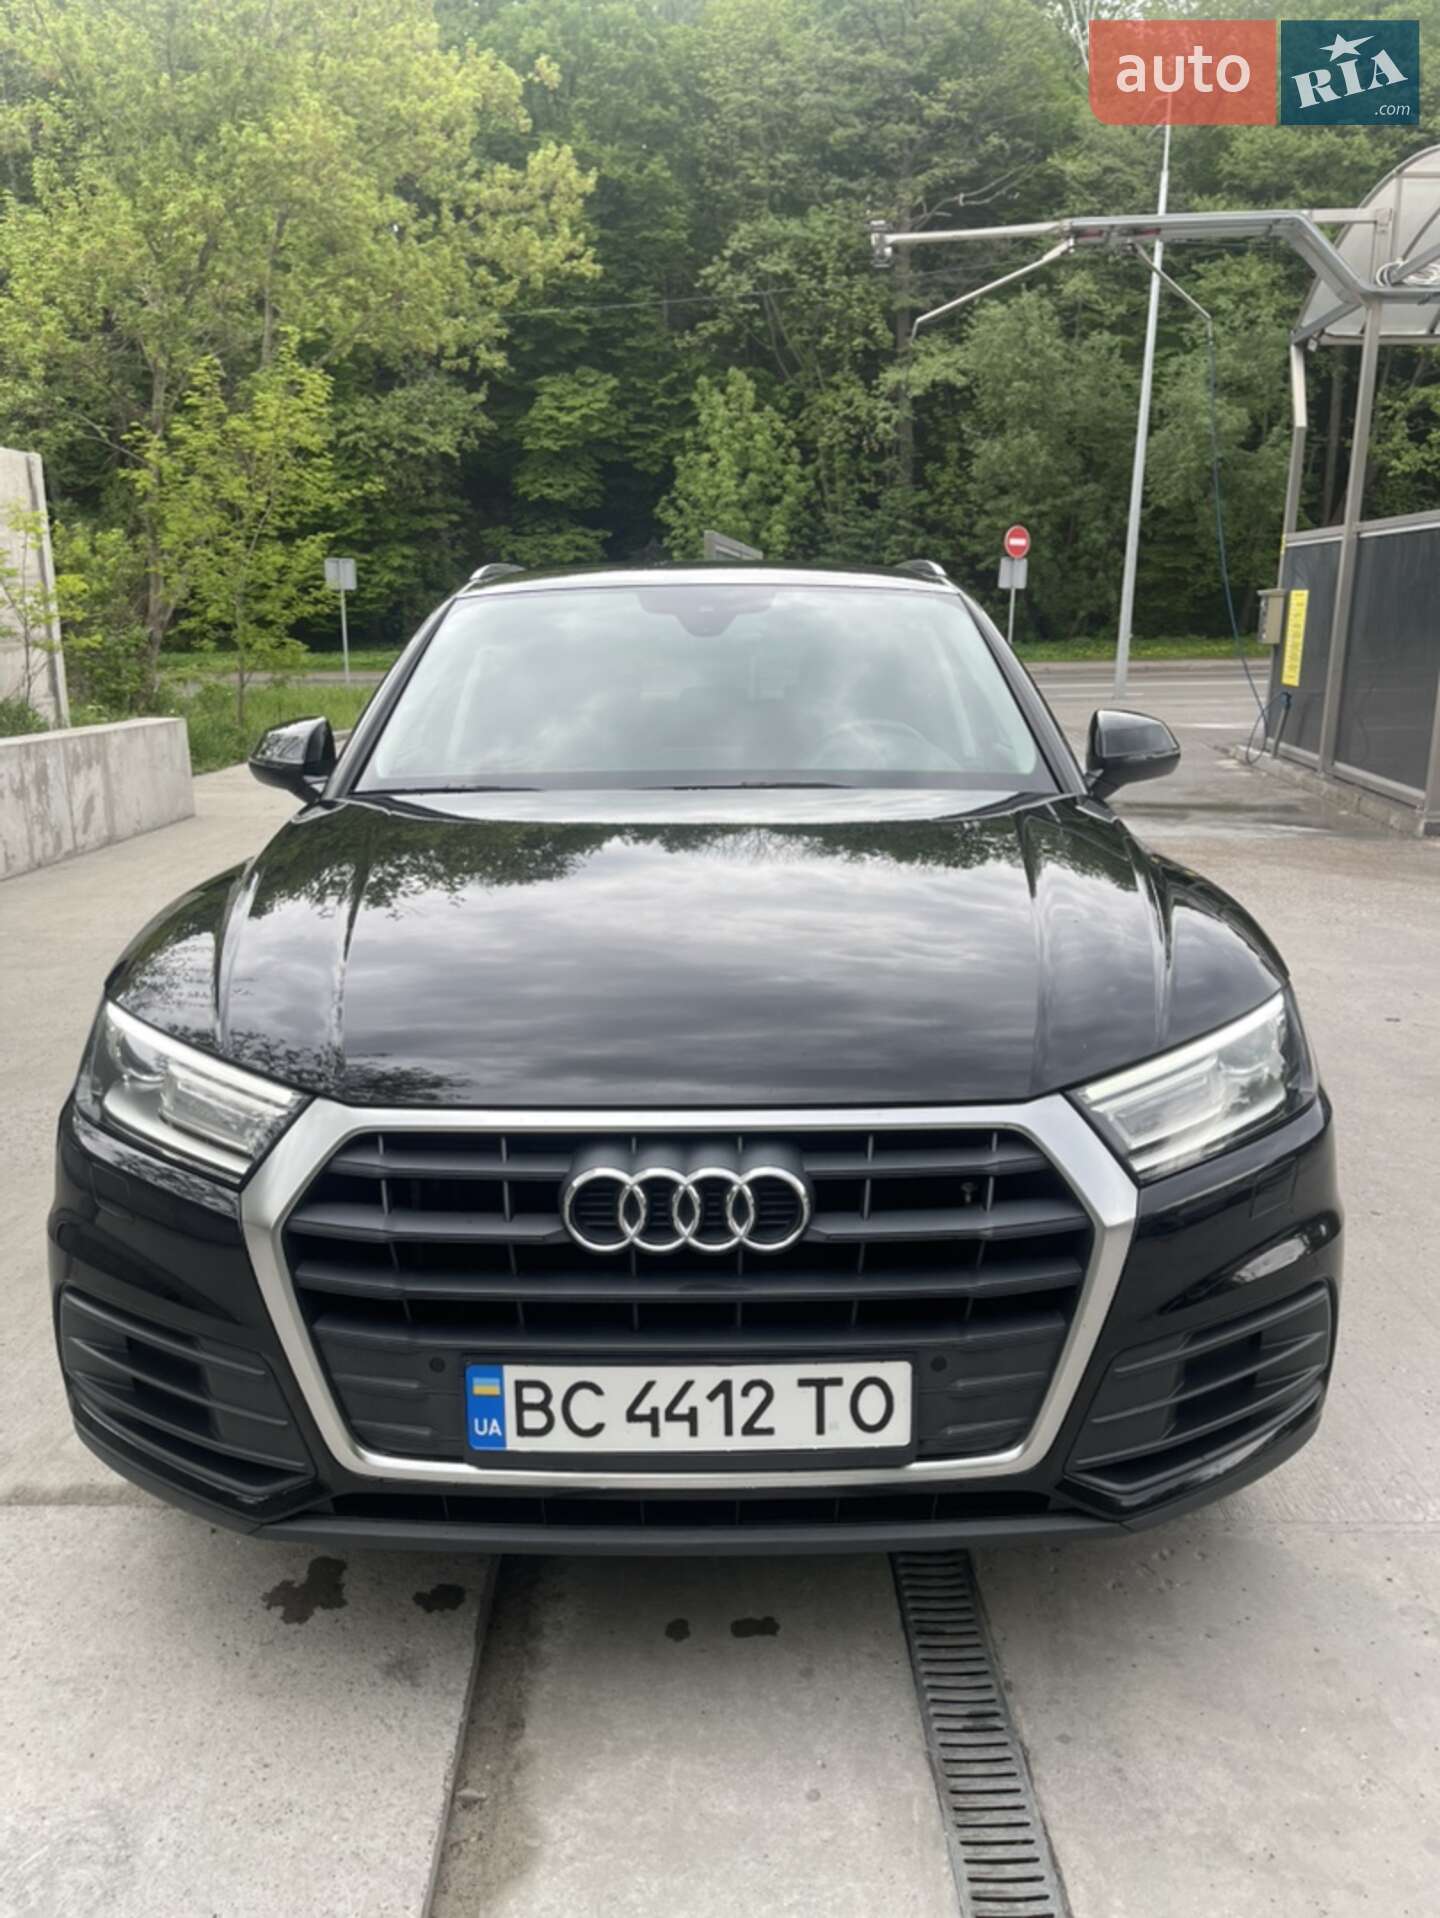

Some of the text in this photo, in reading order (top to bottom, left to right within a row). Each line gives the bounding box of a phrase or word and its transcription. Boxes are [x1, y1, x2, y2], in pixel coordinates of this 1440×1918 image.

[514, 1376, 895, 1438] BC 4412 TO
[474, 1418, 503, 1437] UA
